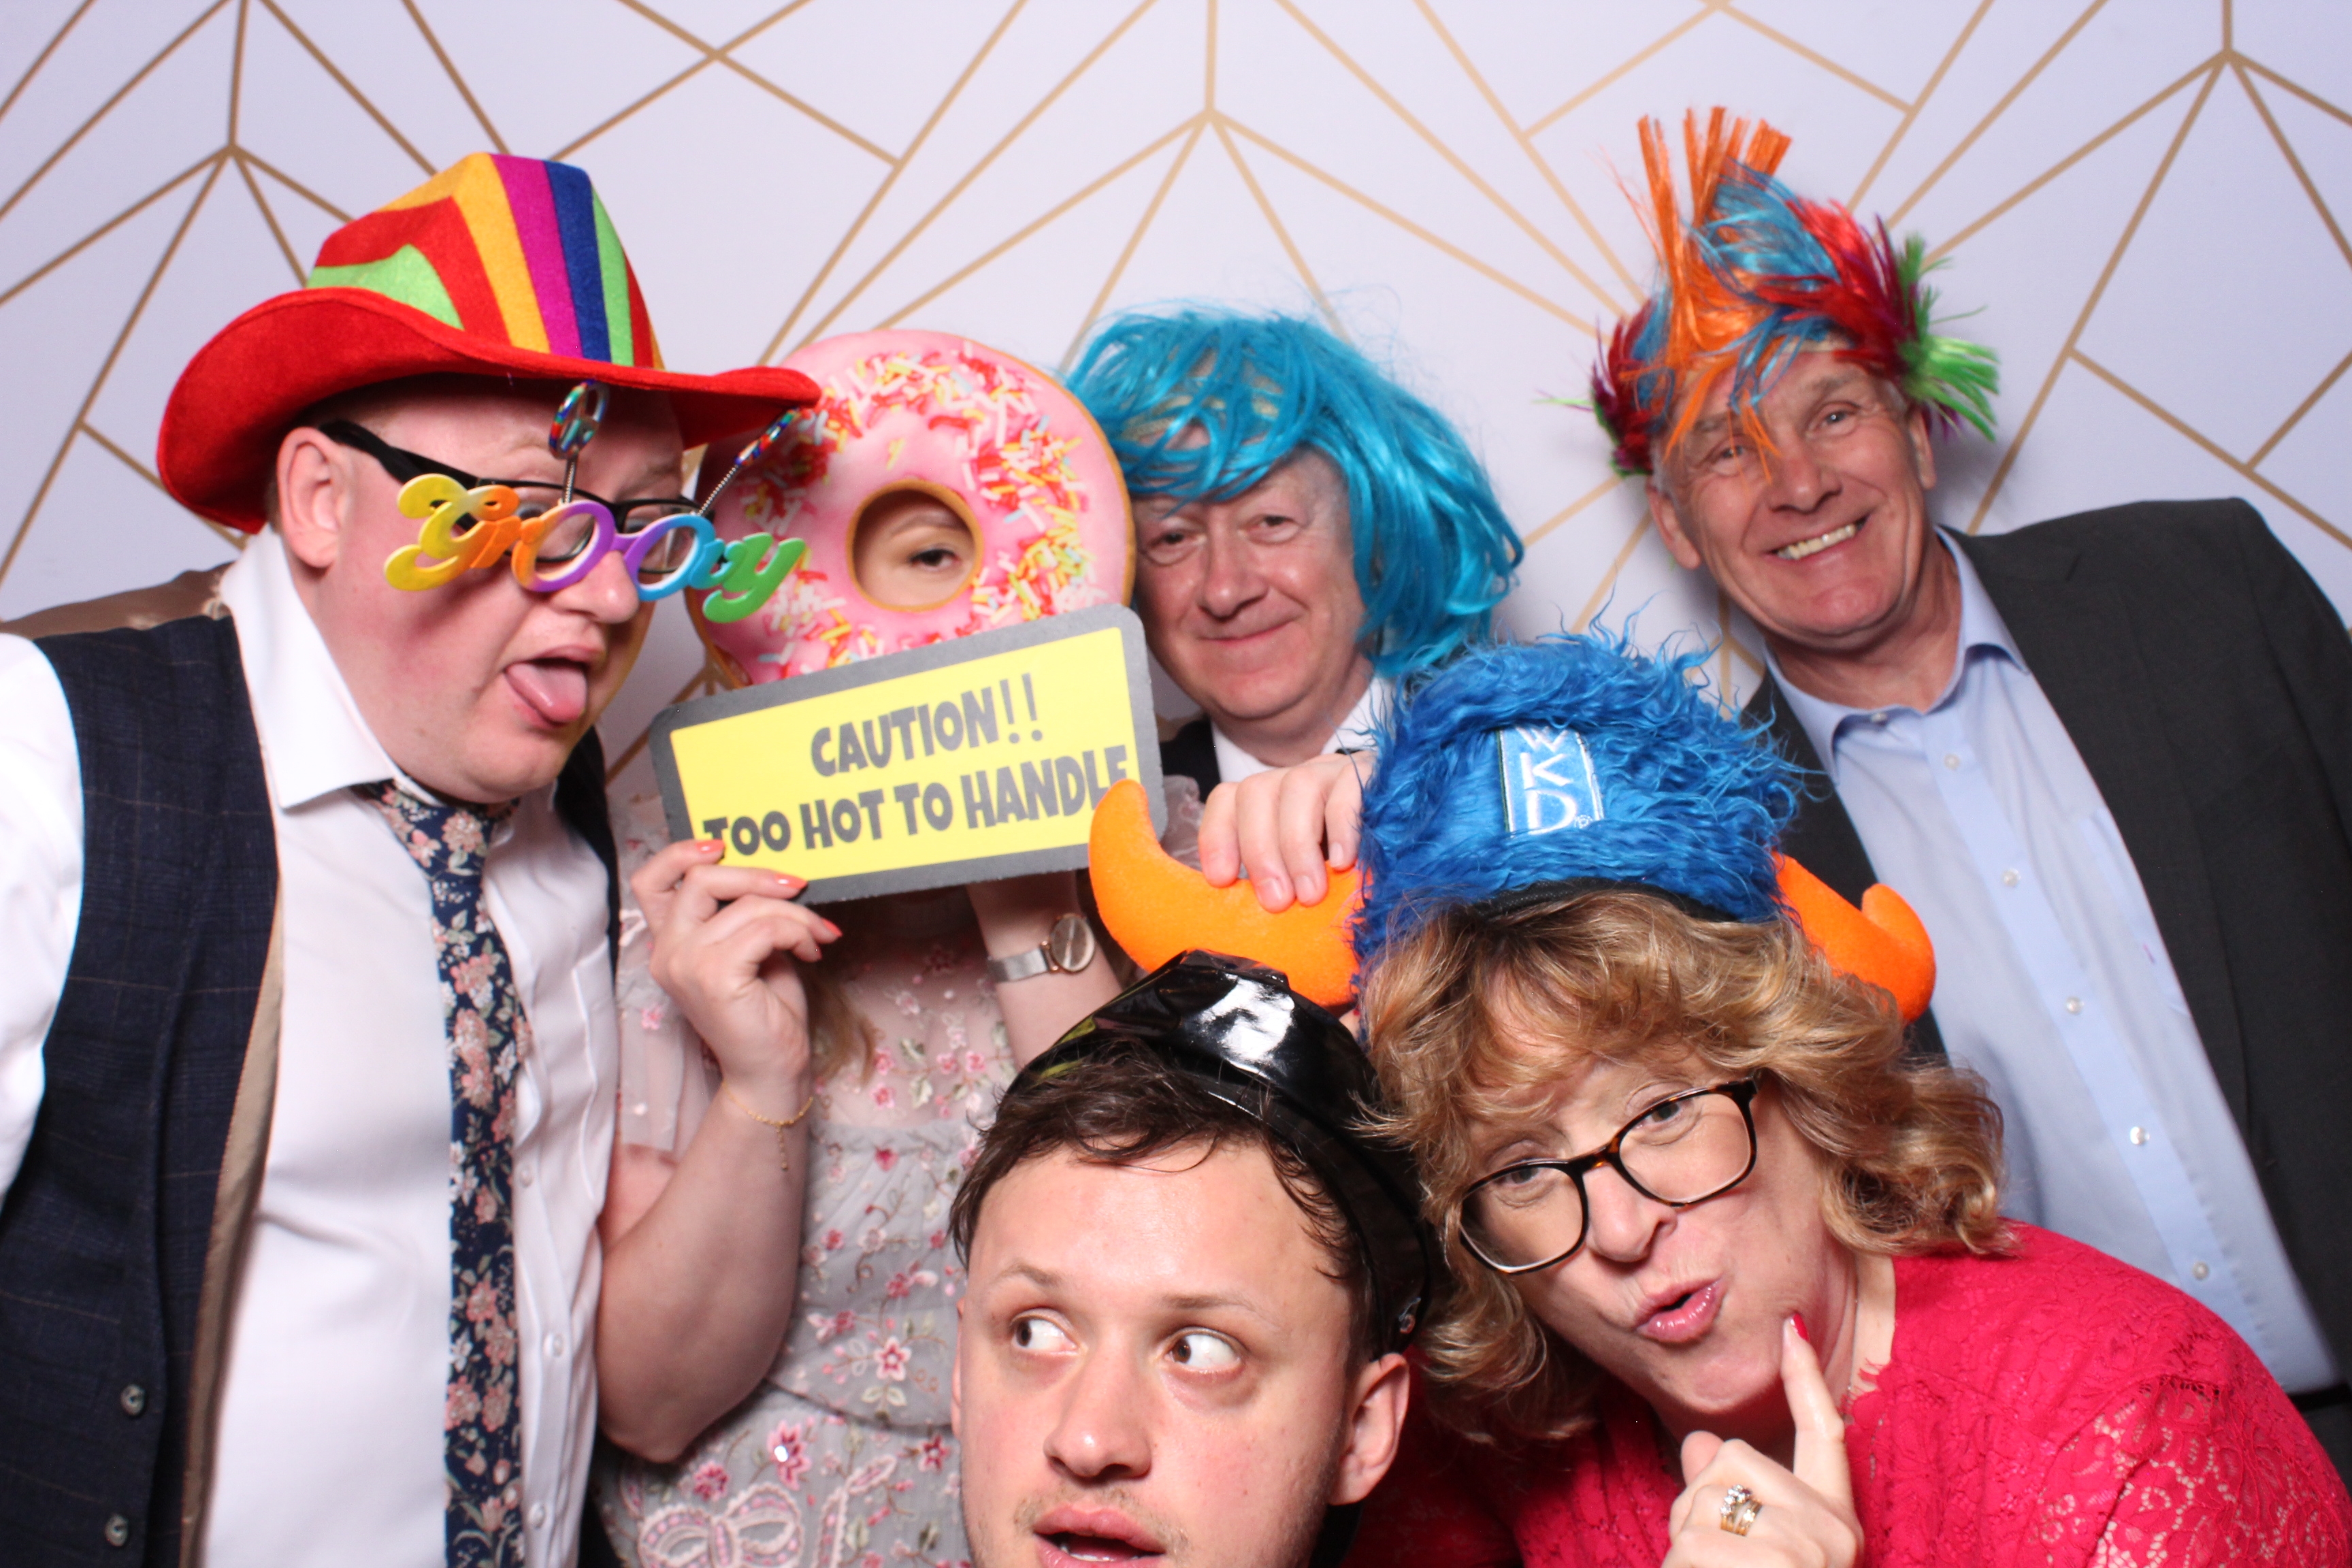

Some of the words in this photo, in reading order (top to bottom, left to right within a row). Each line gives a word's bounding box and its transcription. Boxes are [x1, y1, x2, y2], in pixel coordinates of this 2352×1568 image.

[811, 674, 1043, 777] CAUTION!!
[703, 811, 791, 855] TOO
[799, 789, 885, 849] HOT
[895, 782, 953, 835] TO
